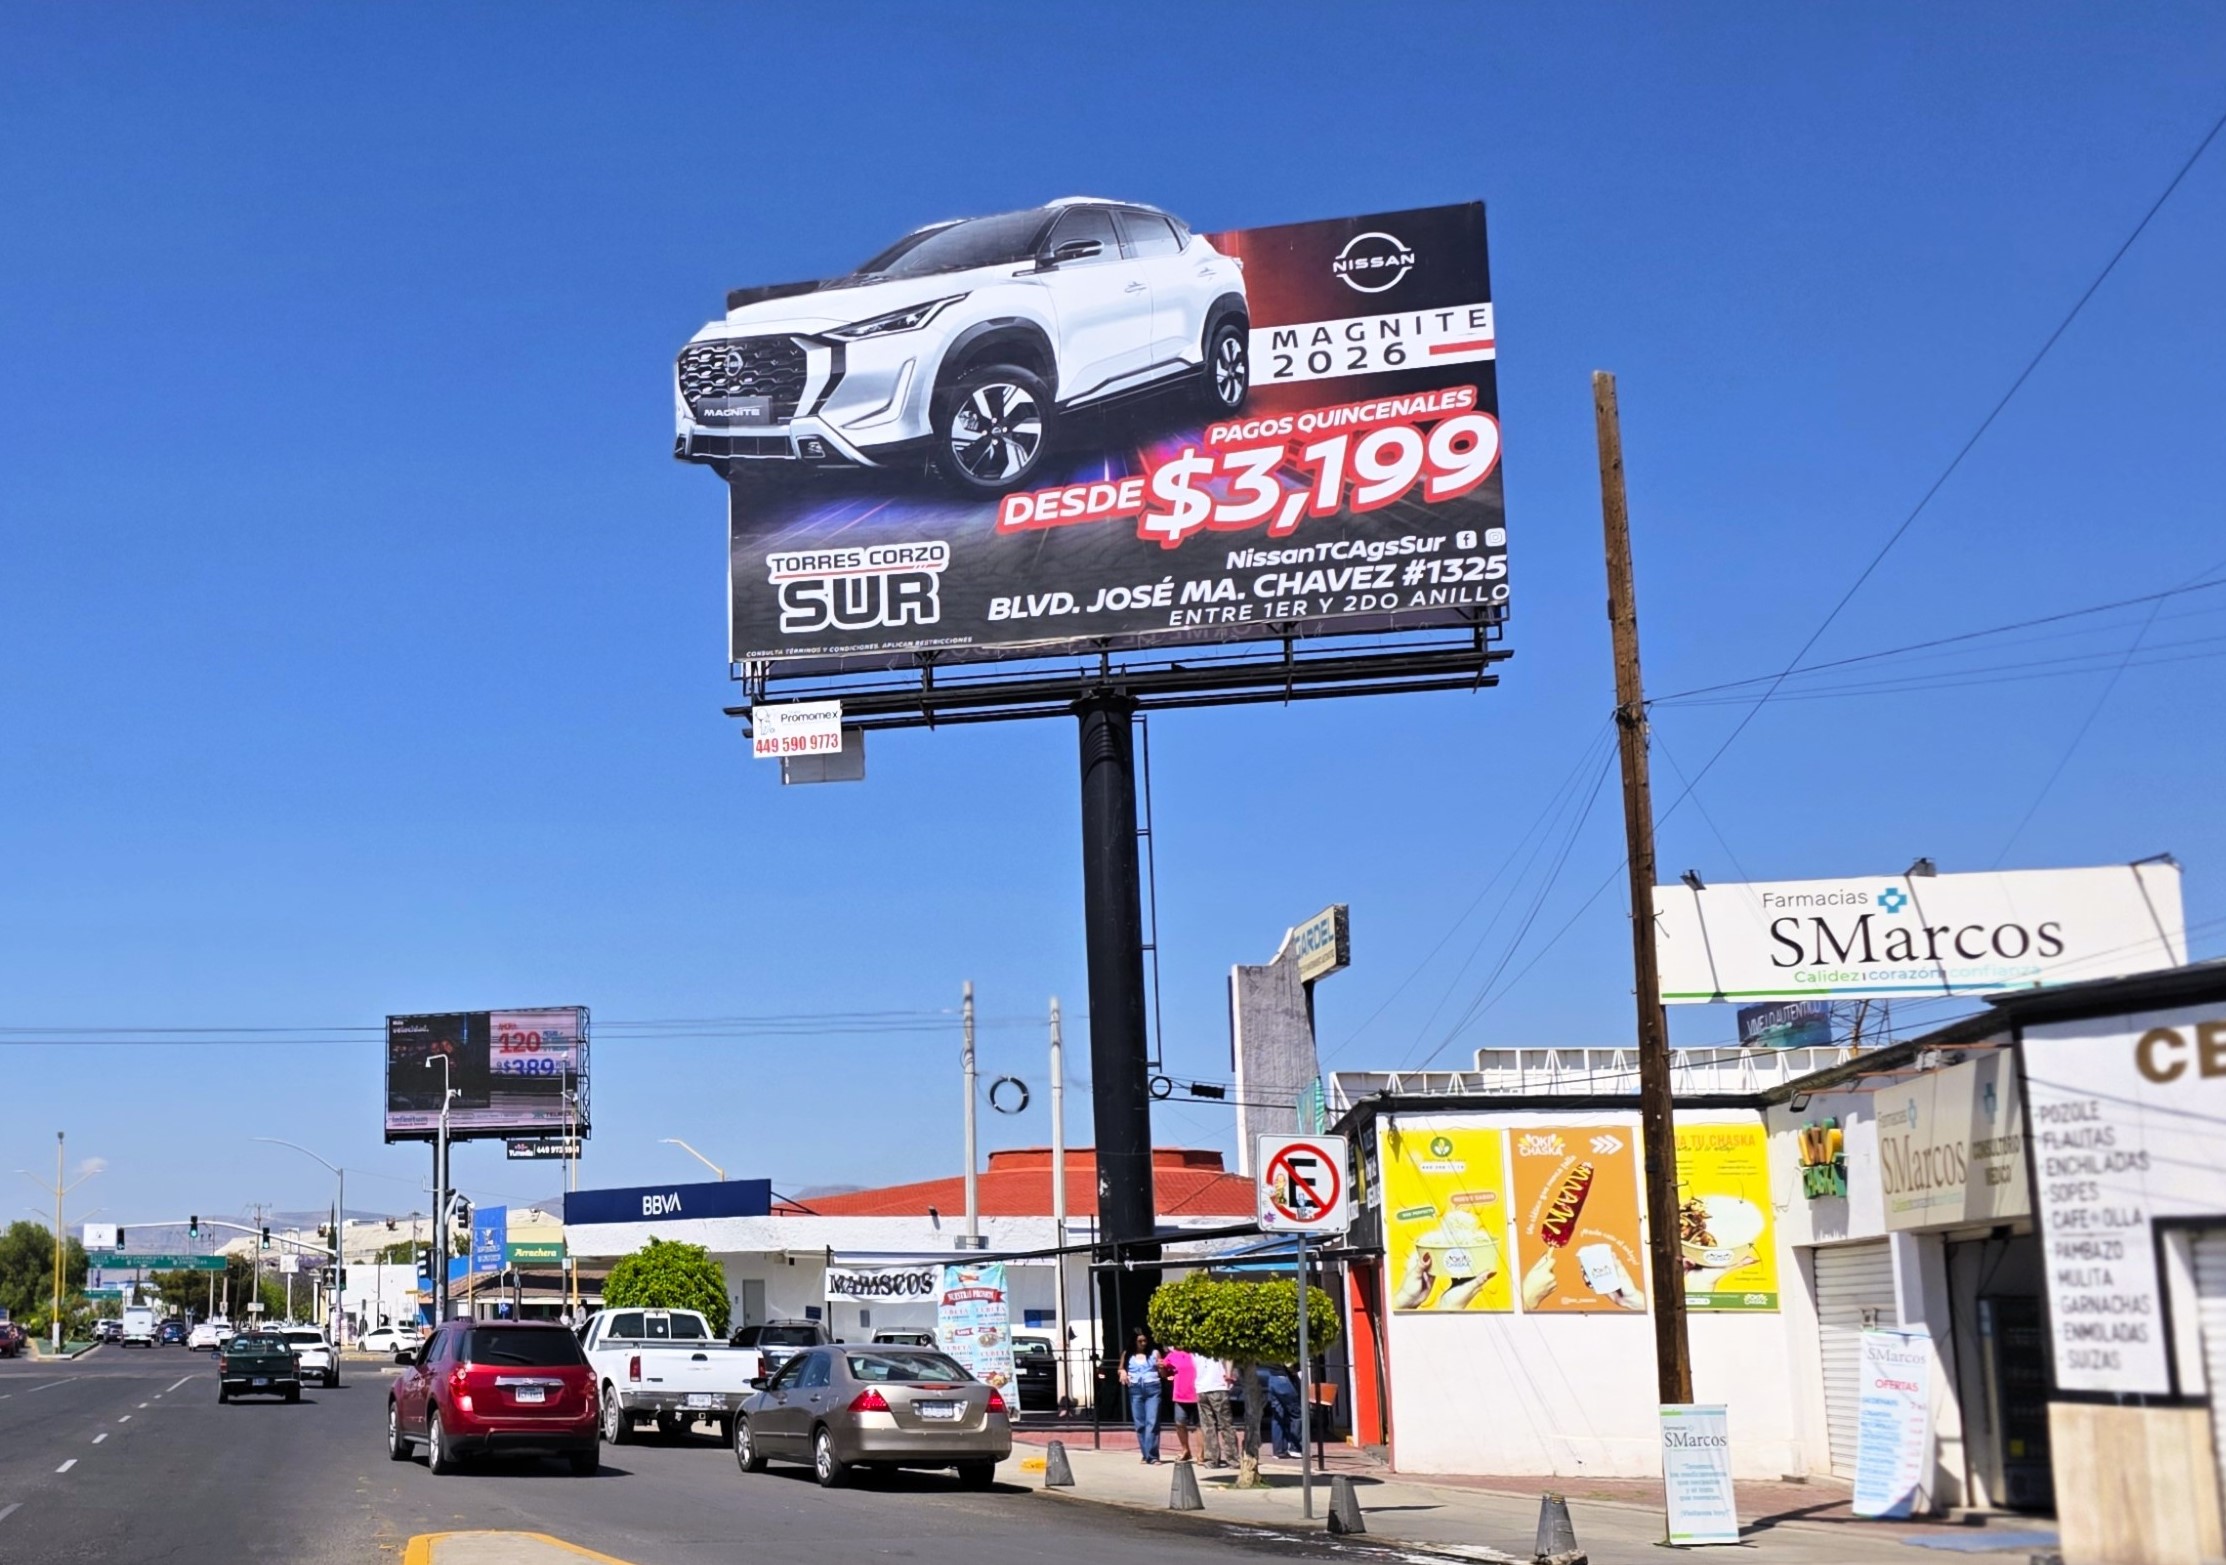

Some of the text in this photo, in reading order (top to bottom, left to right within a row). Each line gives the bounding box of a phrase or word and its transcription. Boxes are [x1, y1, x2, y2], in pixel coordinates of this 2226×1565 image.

[1333, 252, 1415, 273] NISSAN
[1272, 308, 1487, 350] MAGNITE
[1273, 342, 1406, 378] 2026
[704, 407, 760, 417] MAGNITE
[1210, 388, 1473, 445] PAGOS QUINCENALES
[1003, 414, 1498, 541] DESDE $3,199
[772, 545, 944, 573] TORRES CORZO
[1226, 535, 1445, 569] NissanTCAgsSur
[987, 555, 1507, 622] BLVD. JOSÉ MA. CHAVEZ #1325
[783, 571, 935, 629] SUR
[1168, 583, 1511, 626] ENTRE 1ER Y 2DO ANILLO
[780, 709, 838, 723] Promomex
[755, 733, 839, 755] 449 590 9773
[1761, 890, 1869, 910] Farmacias
[1770, 913, 2065, 968] SMarcos
[1794, 962, 2043, 983] Calidez corazón confianza
[2039, 1100, 2101, 1122] POZOLE
[1690, 1135, 1704, 1147] TU
[1709, 1134, 1756, 1147] CHASKA
[2043, 1126, 2115, 1150] FLAUTAS
[1519, 1145, 1564, 1157] CHASKA
[1881, 1135, 1967, 1195] SMarcos
[2046, 1151, 2149, 1178] ENCHILADAS
[2050, 1182, 2099, 1202] SOPES
[642, 1192, 681, 1215] BBVA
[2104, 1208, 2143, 1228] OLLA
[2055, 1241, 2124, 1260] PAMBAZO
[828, 1272, 934, 1296] MARISCOS
[2057, 1269, 2113, 1288] MULITA
[2061, 1294, 2150, 1316] GARNACHAS
[1867, 1347, 1926, 1365] SMarcos
[1875, 1379, 1919, 1392] OFERTAS
[1664, 1431, 1727, 1448] SMarcos
